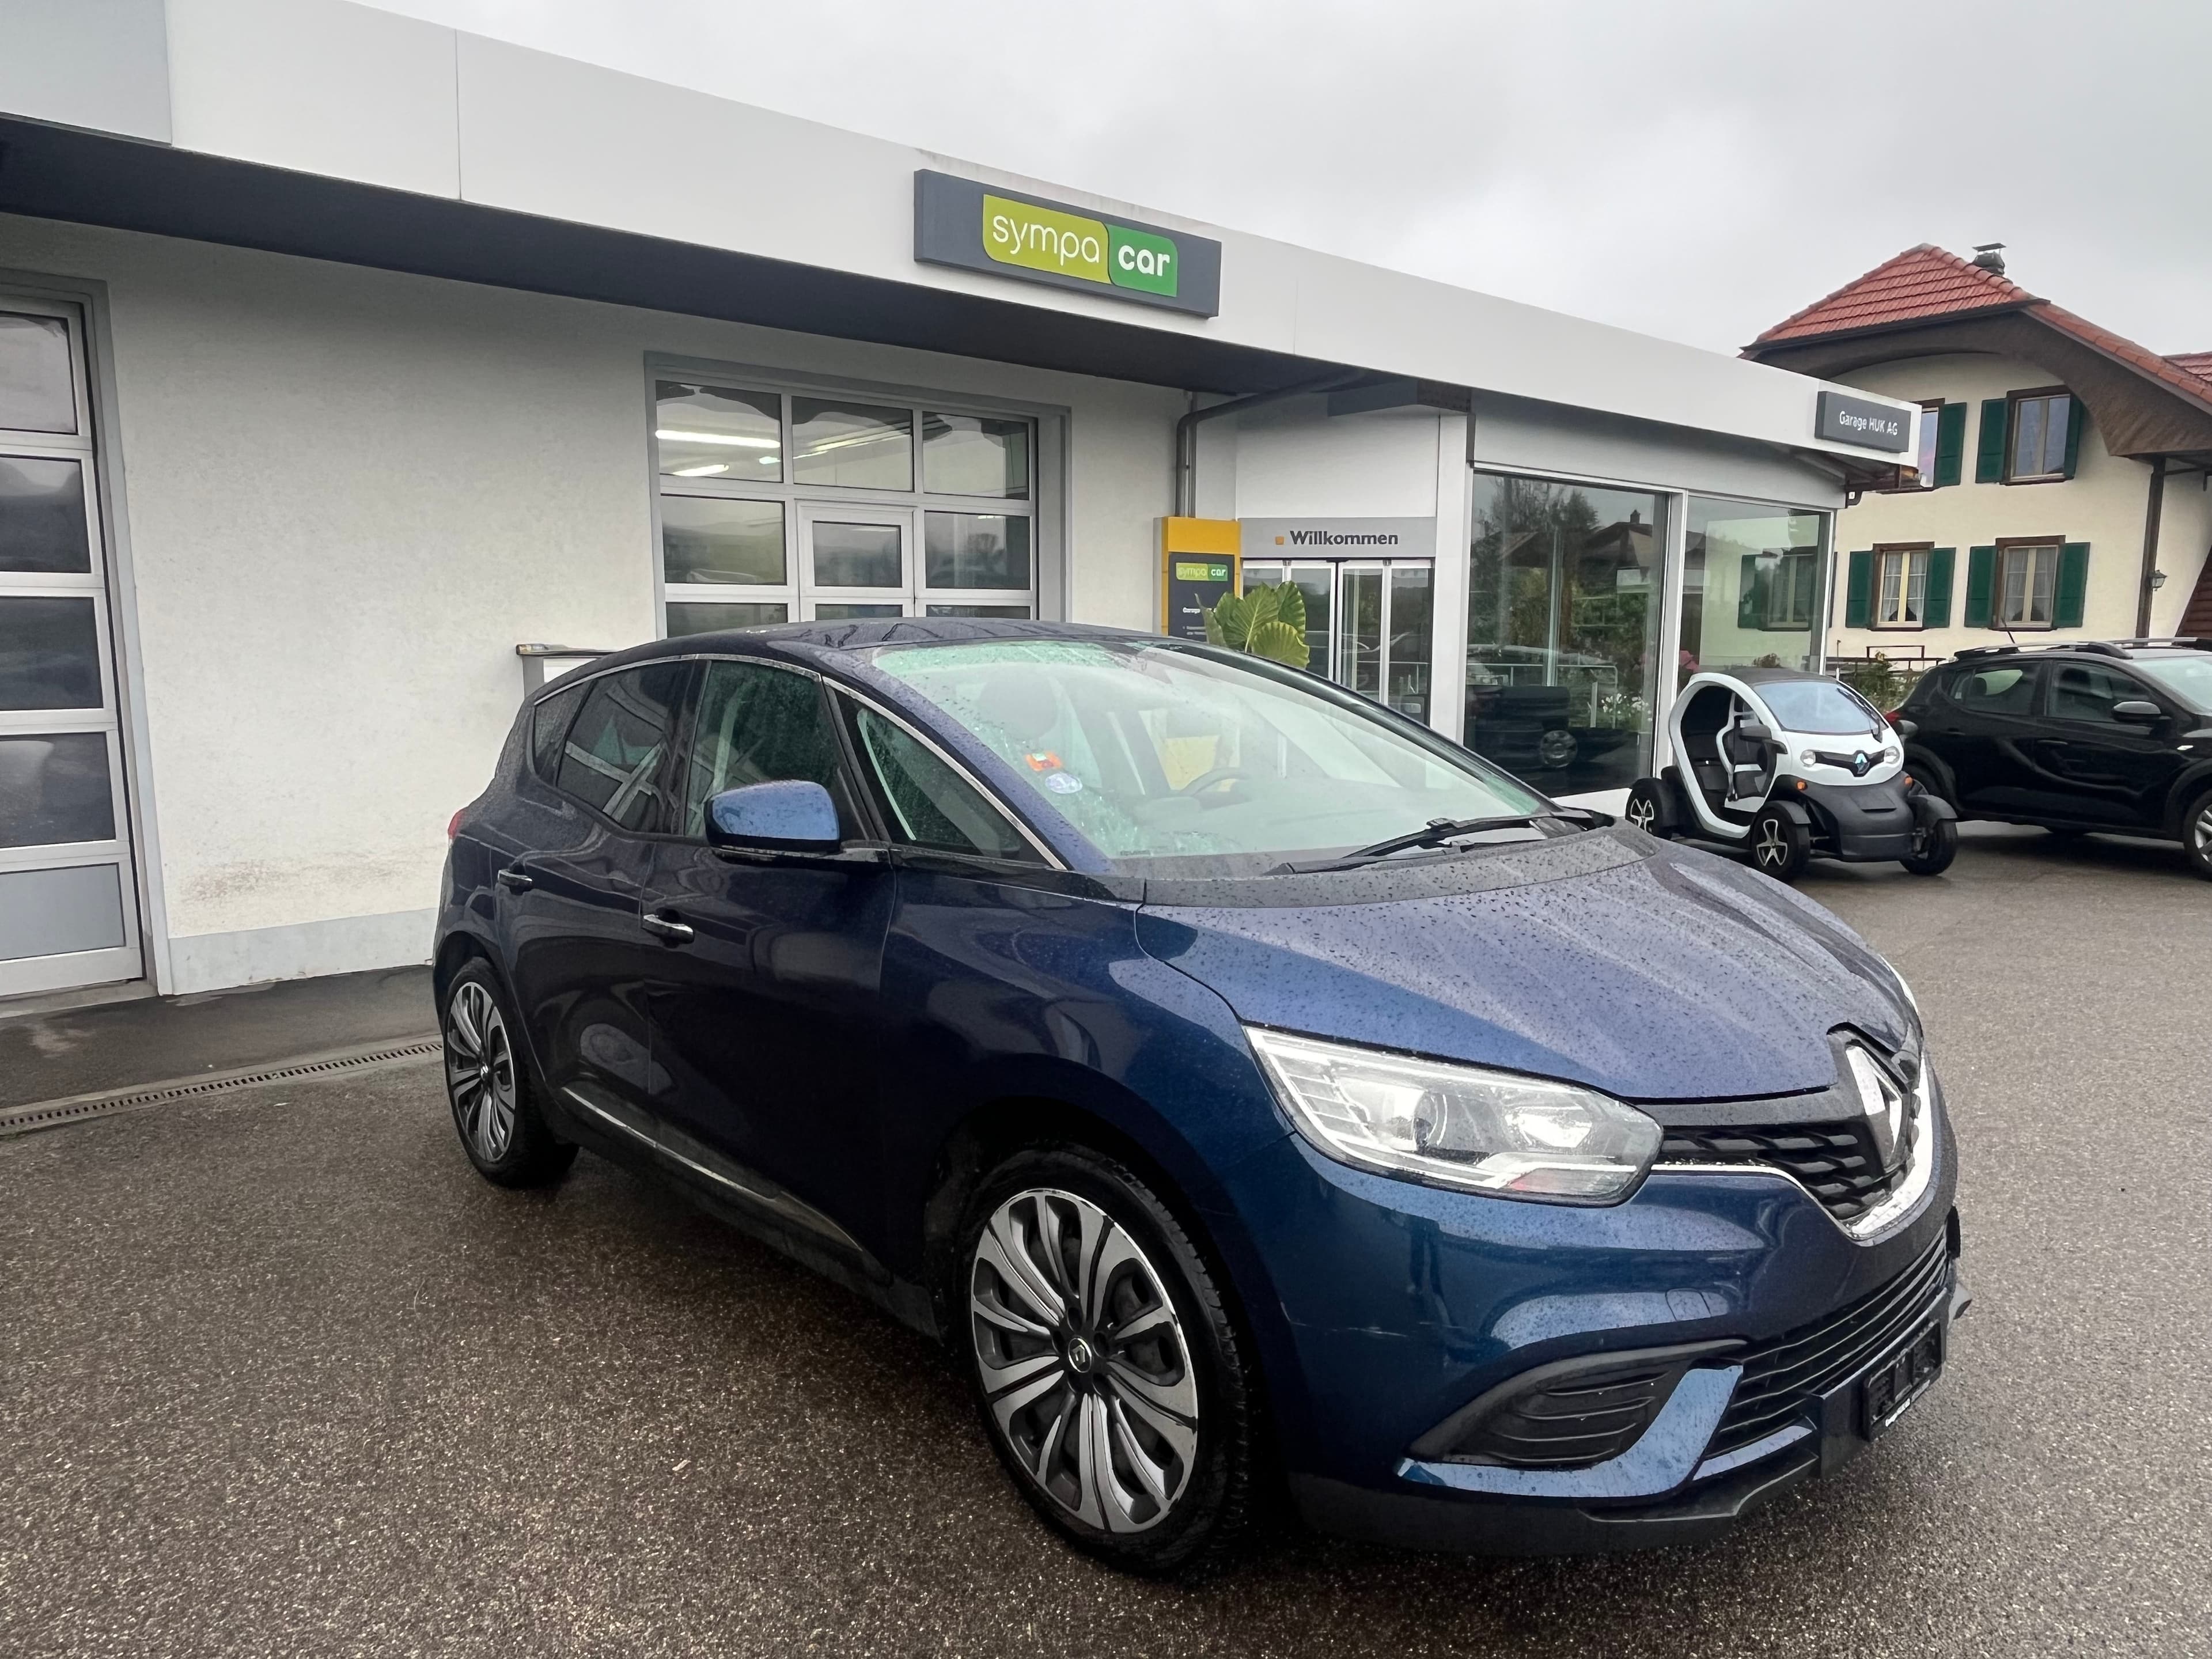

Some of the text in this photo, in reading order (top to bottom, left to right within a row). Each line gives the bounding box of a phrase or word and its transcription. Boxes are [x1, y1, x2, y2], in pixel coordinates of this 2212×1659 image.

[993, 215, 1170, 276] sympa car
[1840, 411, 1897, 435] Garage HUK AG
[1290, 531, 1398, 545] Willkommen
